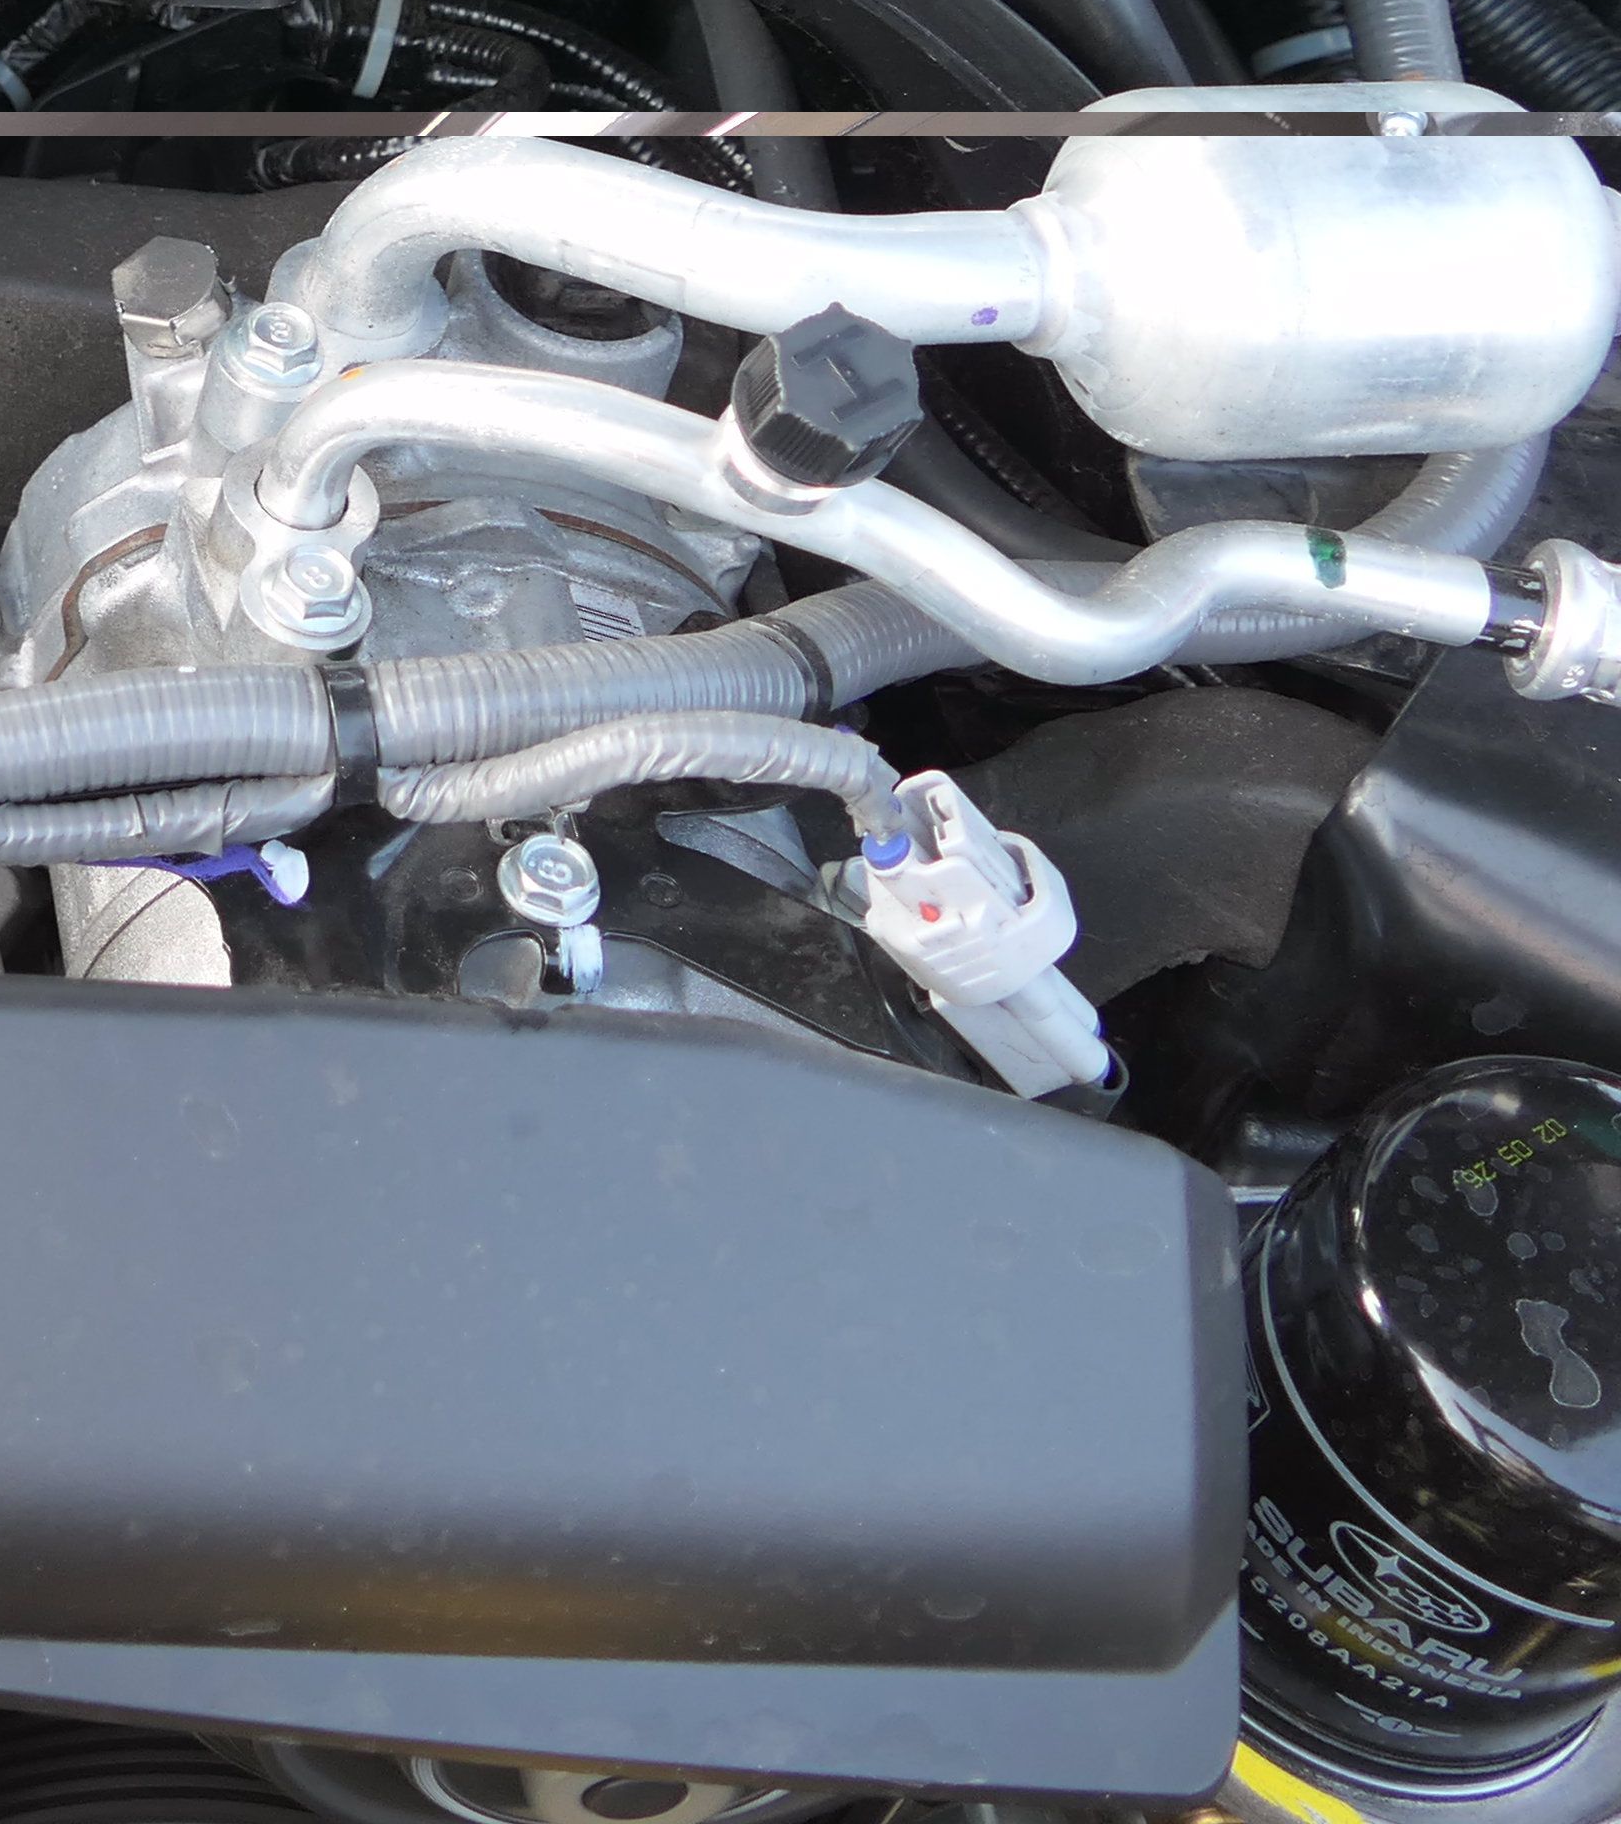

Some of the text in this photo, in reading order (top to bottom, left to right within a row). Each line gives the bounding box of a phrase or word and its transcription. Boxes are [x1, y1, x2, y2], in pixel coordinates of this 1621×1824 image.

[1246, 1519, 1522, 1701] ADE IN INDONESIA
[1253, 1495, 1524, 1683] SUBARU
